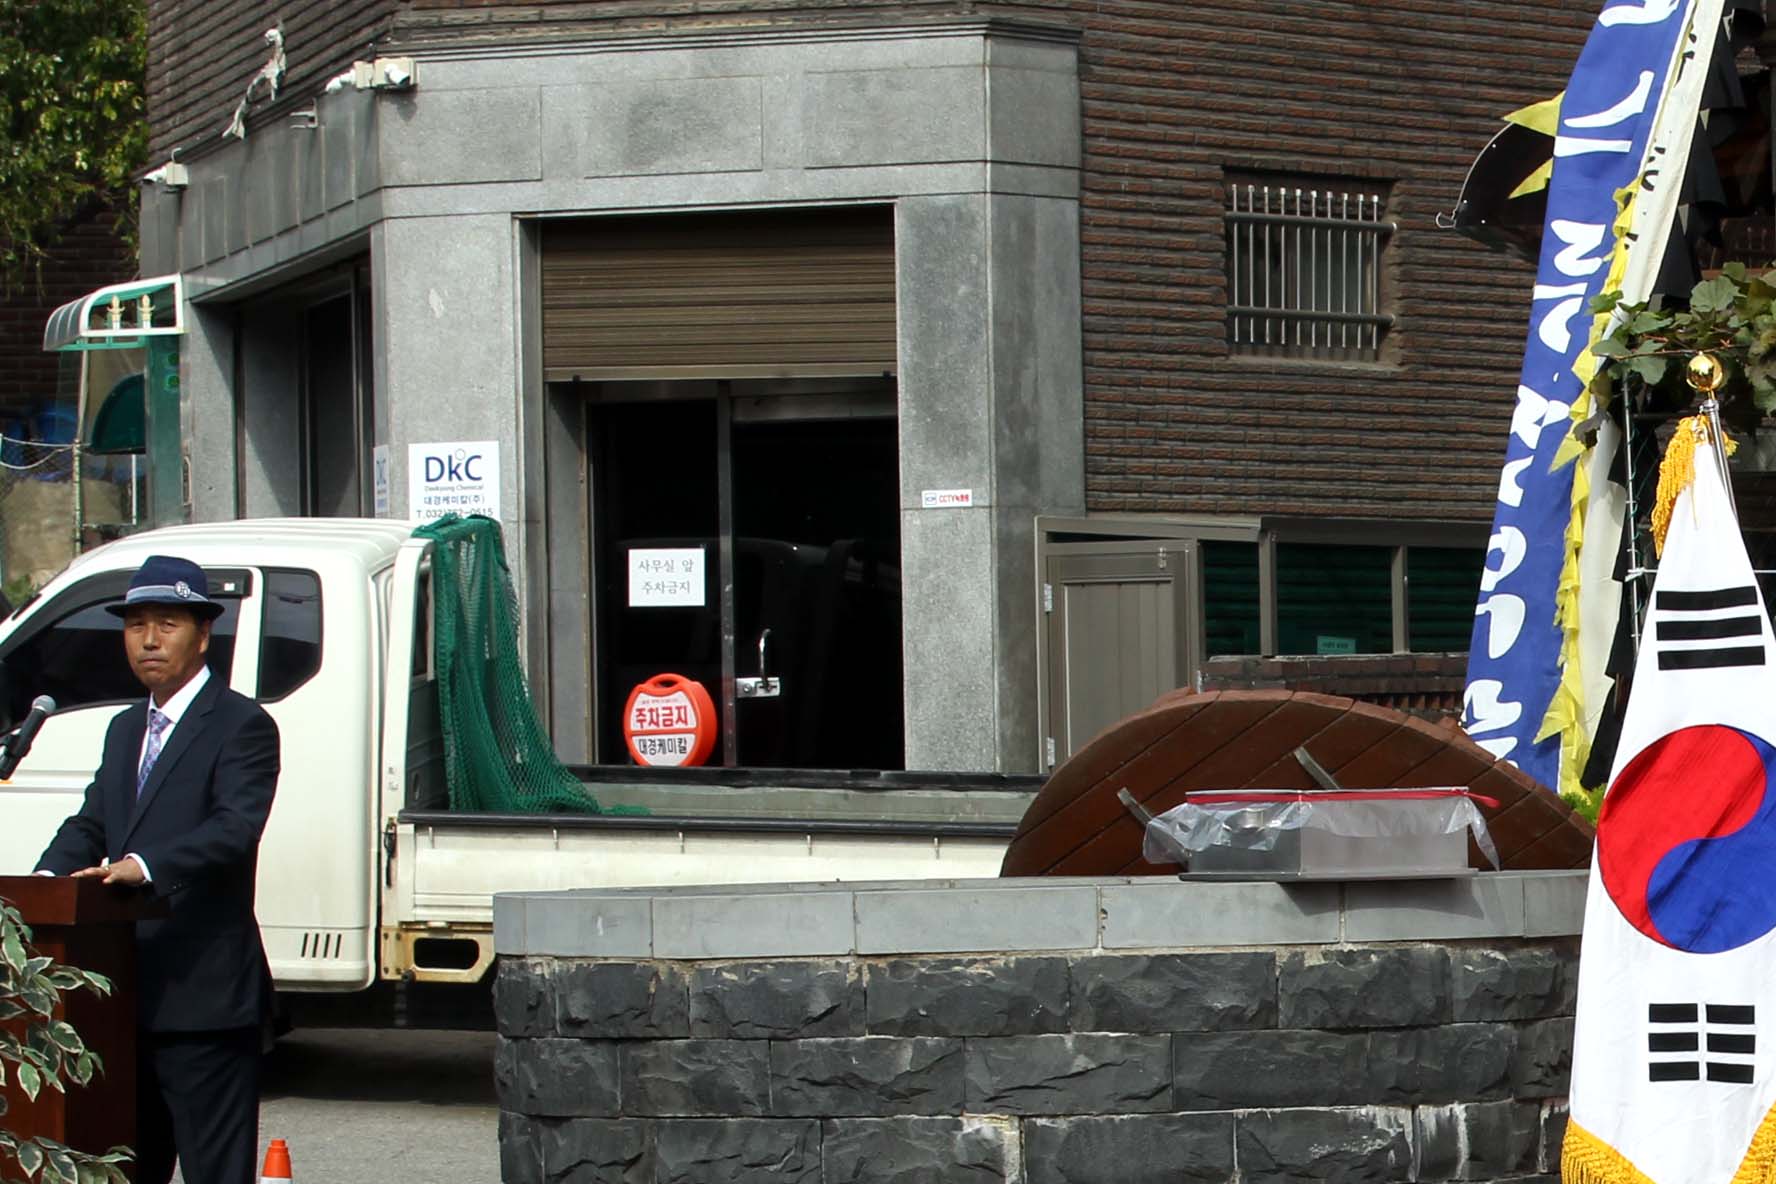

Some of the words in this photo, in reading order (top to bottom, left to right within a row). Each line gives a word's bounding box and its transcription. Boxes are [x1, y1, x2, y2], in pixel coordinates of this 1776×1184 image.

[425, 454, 482, 482] DkC
[638, 559, 675, 573] 사무실
[682, 559, 695, 573] 앞
[641, 580, 691, 595] 주차금지
[635, 705, 689, 729] 주차금지
[638, 737, 688, 756] 대경케미칼
